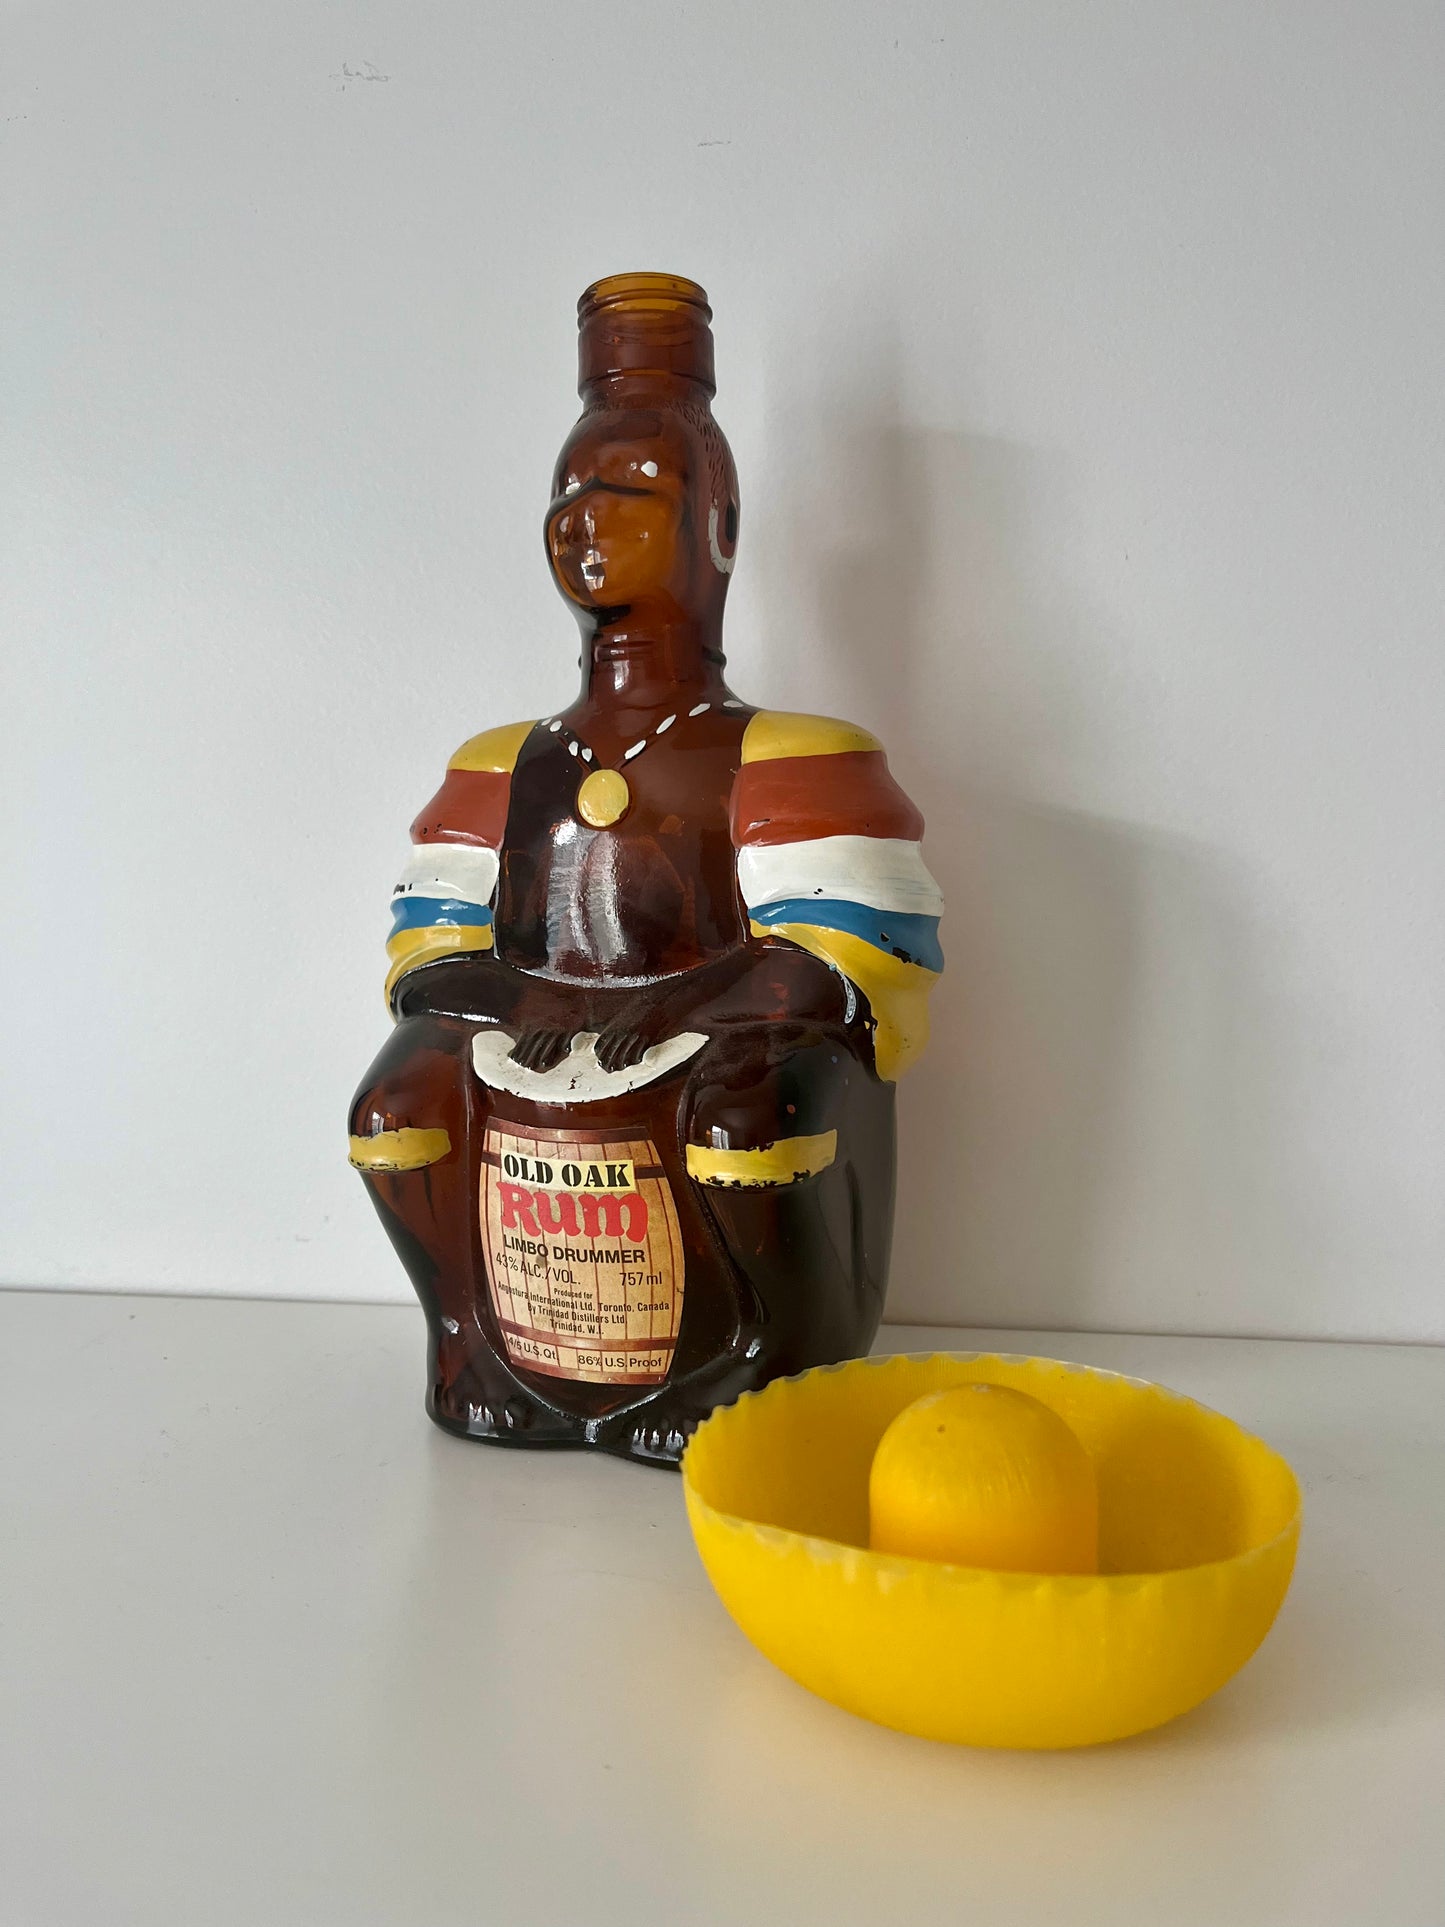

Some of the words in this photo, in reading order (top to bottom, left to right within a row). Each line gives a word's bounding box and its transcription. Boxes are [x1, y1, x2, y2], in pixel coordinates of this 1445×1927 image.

[504, 1154, 553, 1185] OLD
[561, 1163, 631, 1187] OAK
[496, 1181, 648, 1243] Rum
[504, 1234, 548, 1257] LIMBO
[553, 1246, 645, 1264] DRUMMER
[495, 1252, 519, 1271] 43%
[530, 1292, 578, 1309] International
[637, 1301, 670, 1311] Canada
[554, 1287, 582, 1298] Produced
[583, 1291, 593, 1299] for
[527, 1302, 536, 1315] By
[538, 1305, 569, 1319] Trinidad
[571, 1311, 609, 1323] Distillers
[578, 1355, 603, 1366] 86%
[629, 1357, 662, 1367] Proof
